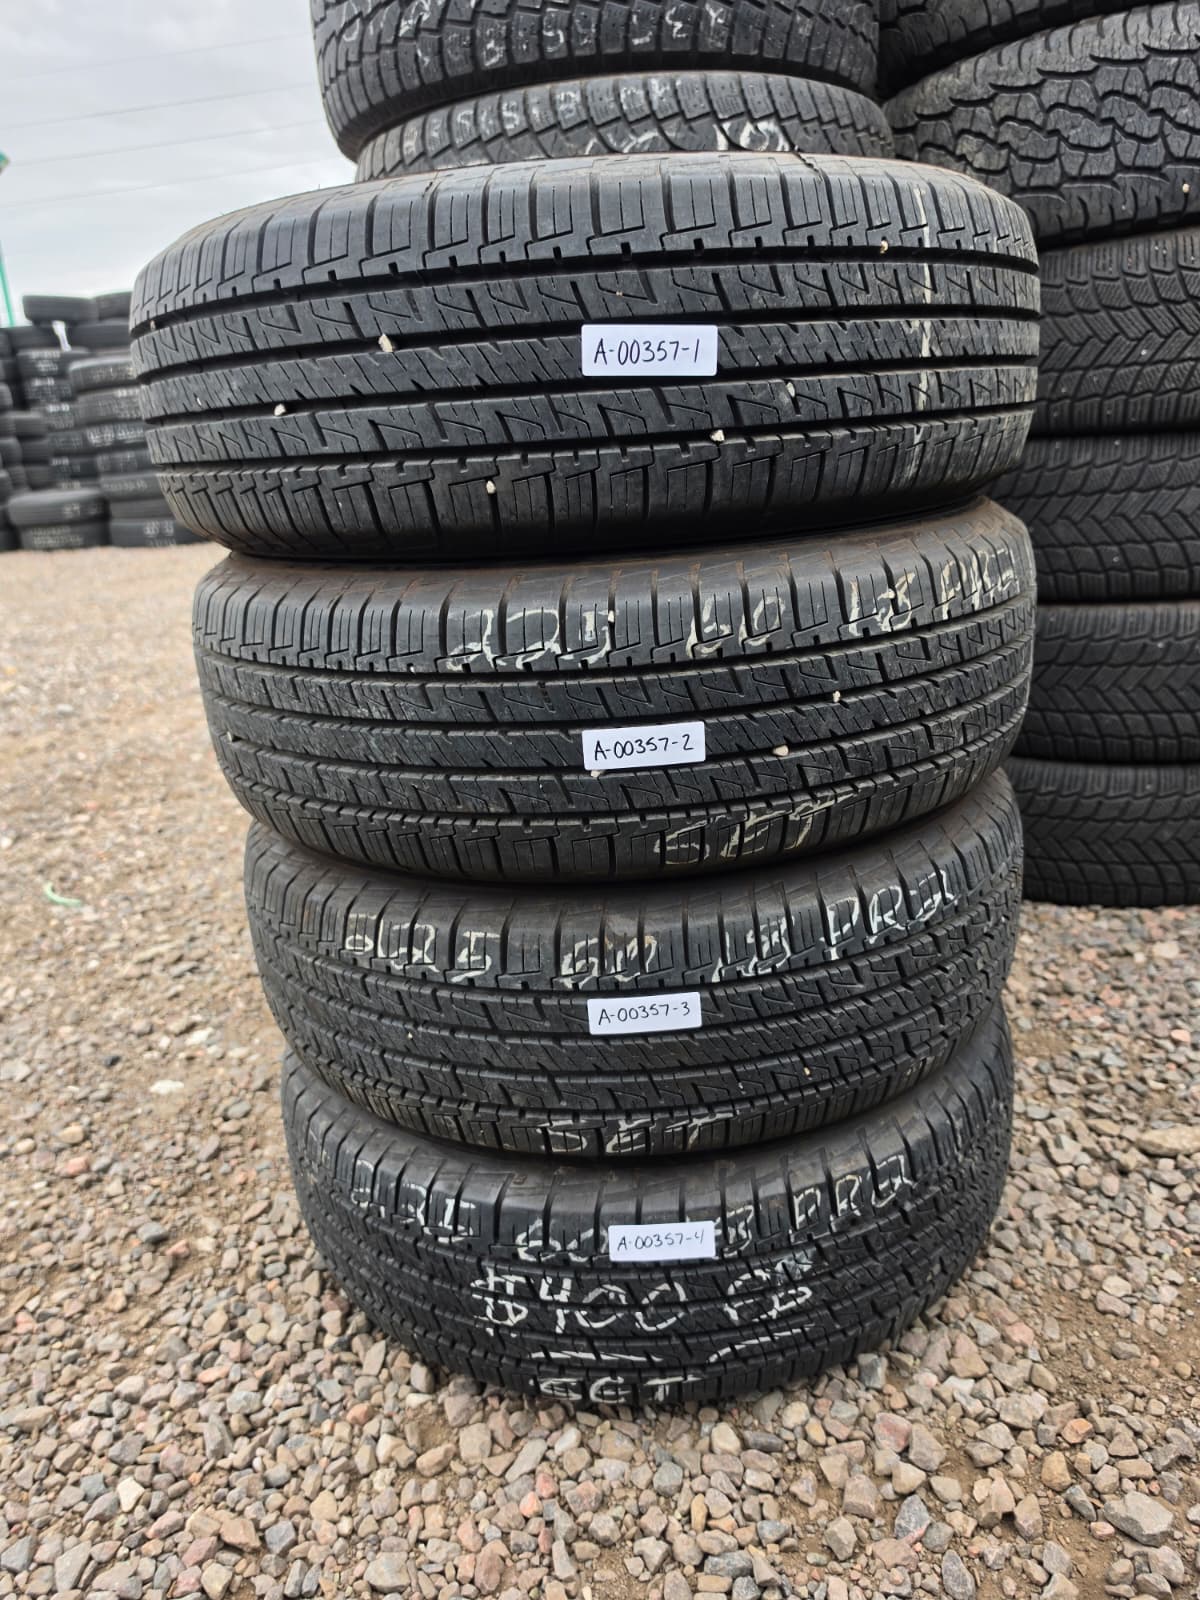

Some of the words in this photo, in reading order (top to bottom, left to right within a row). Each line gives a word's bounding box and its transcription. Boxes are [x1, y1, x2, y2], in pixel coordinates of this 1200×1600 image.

[594, 338, 700, 366] A-00357-1
[686, 596, 786, 659] 60
[594, 733, 695, 761] A-00357-2
[598, 1001, 691, 1026] A-00357-3
[616, 1228, 705, 1252] A-00357-4
